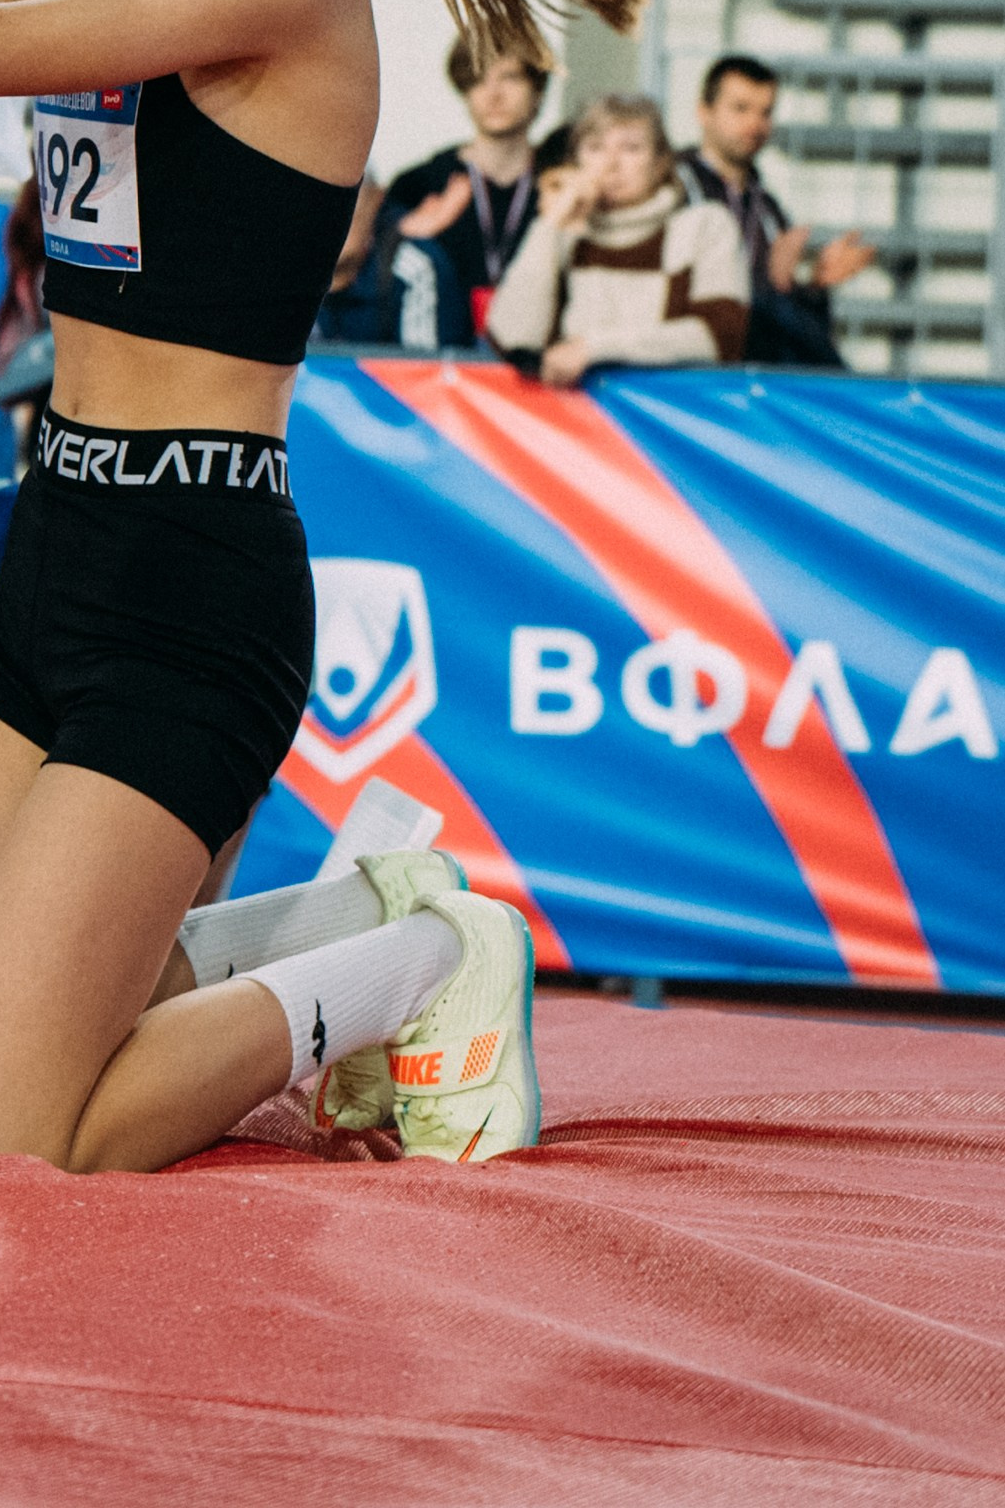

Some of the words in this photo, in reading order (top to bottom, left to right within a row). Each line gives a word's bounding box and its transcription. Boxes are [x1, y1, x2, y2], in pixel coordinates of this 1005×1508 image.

[38, 131, 100, 223] 492
[50, 239, 70, 256] ВФЛА
[510, 625, 998, 759] ВФЛА
[388, 1051, 443, 1086] NIKE
